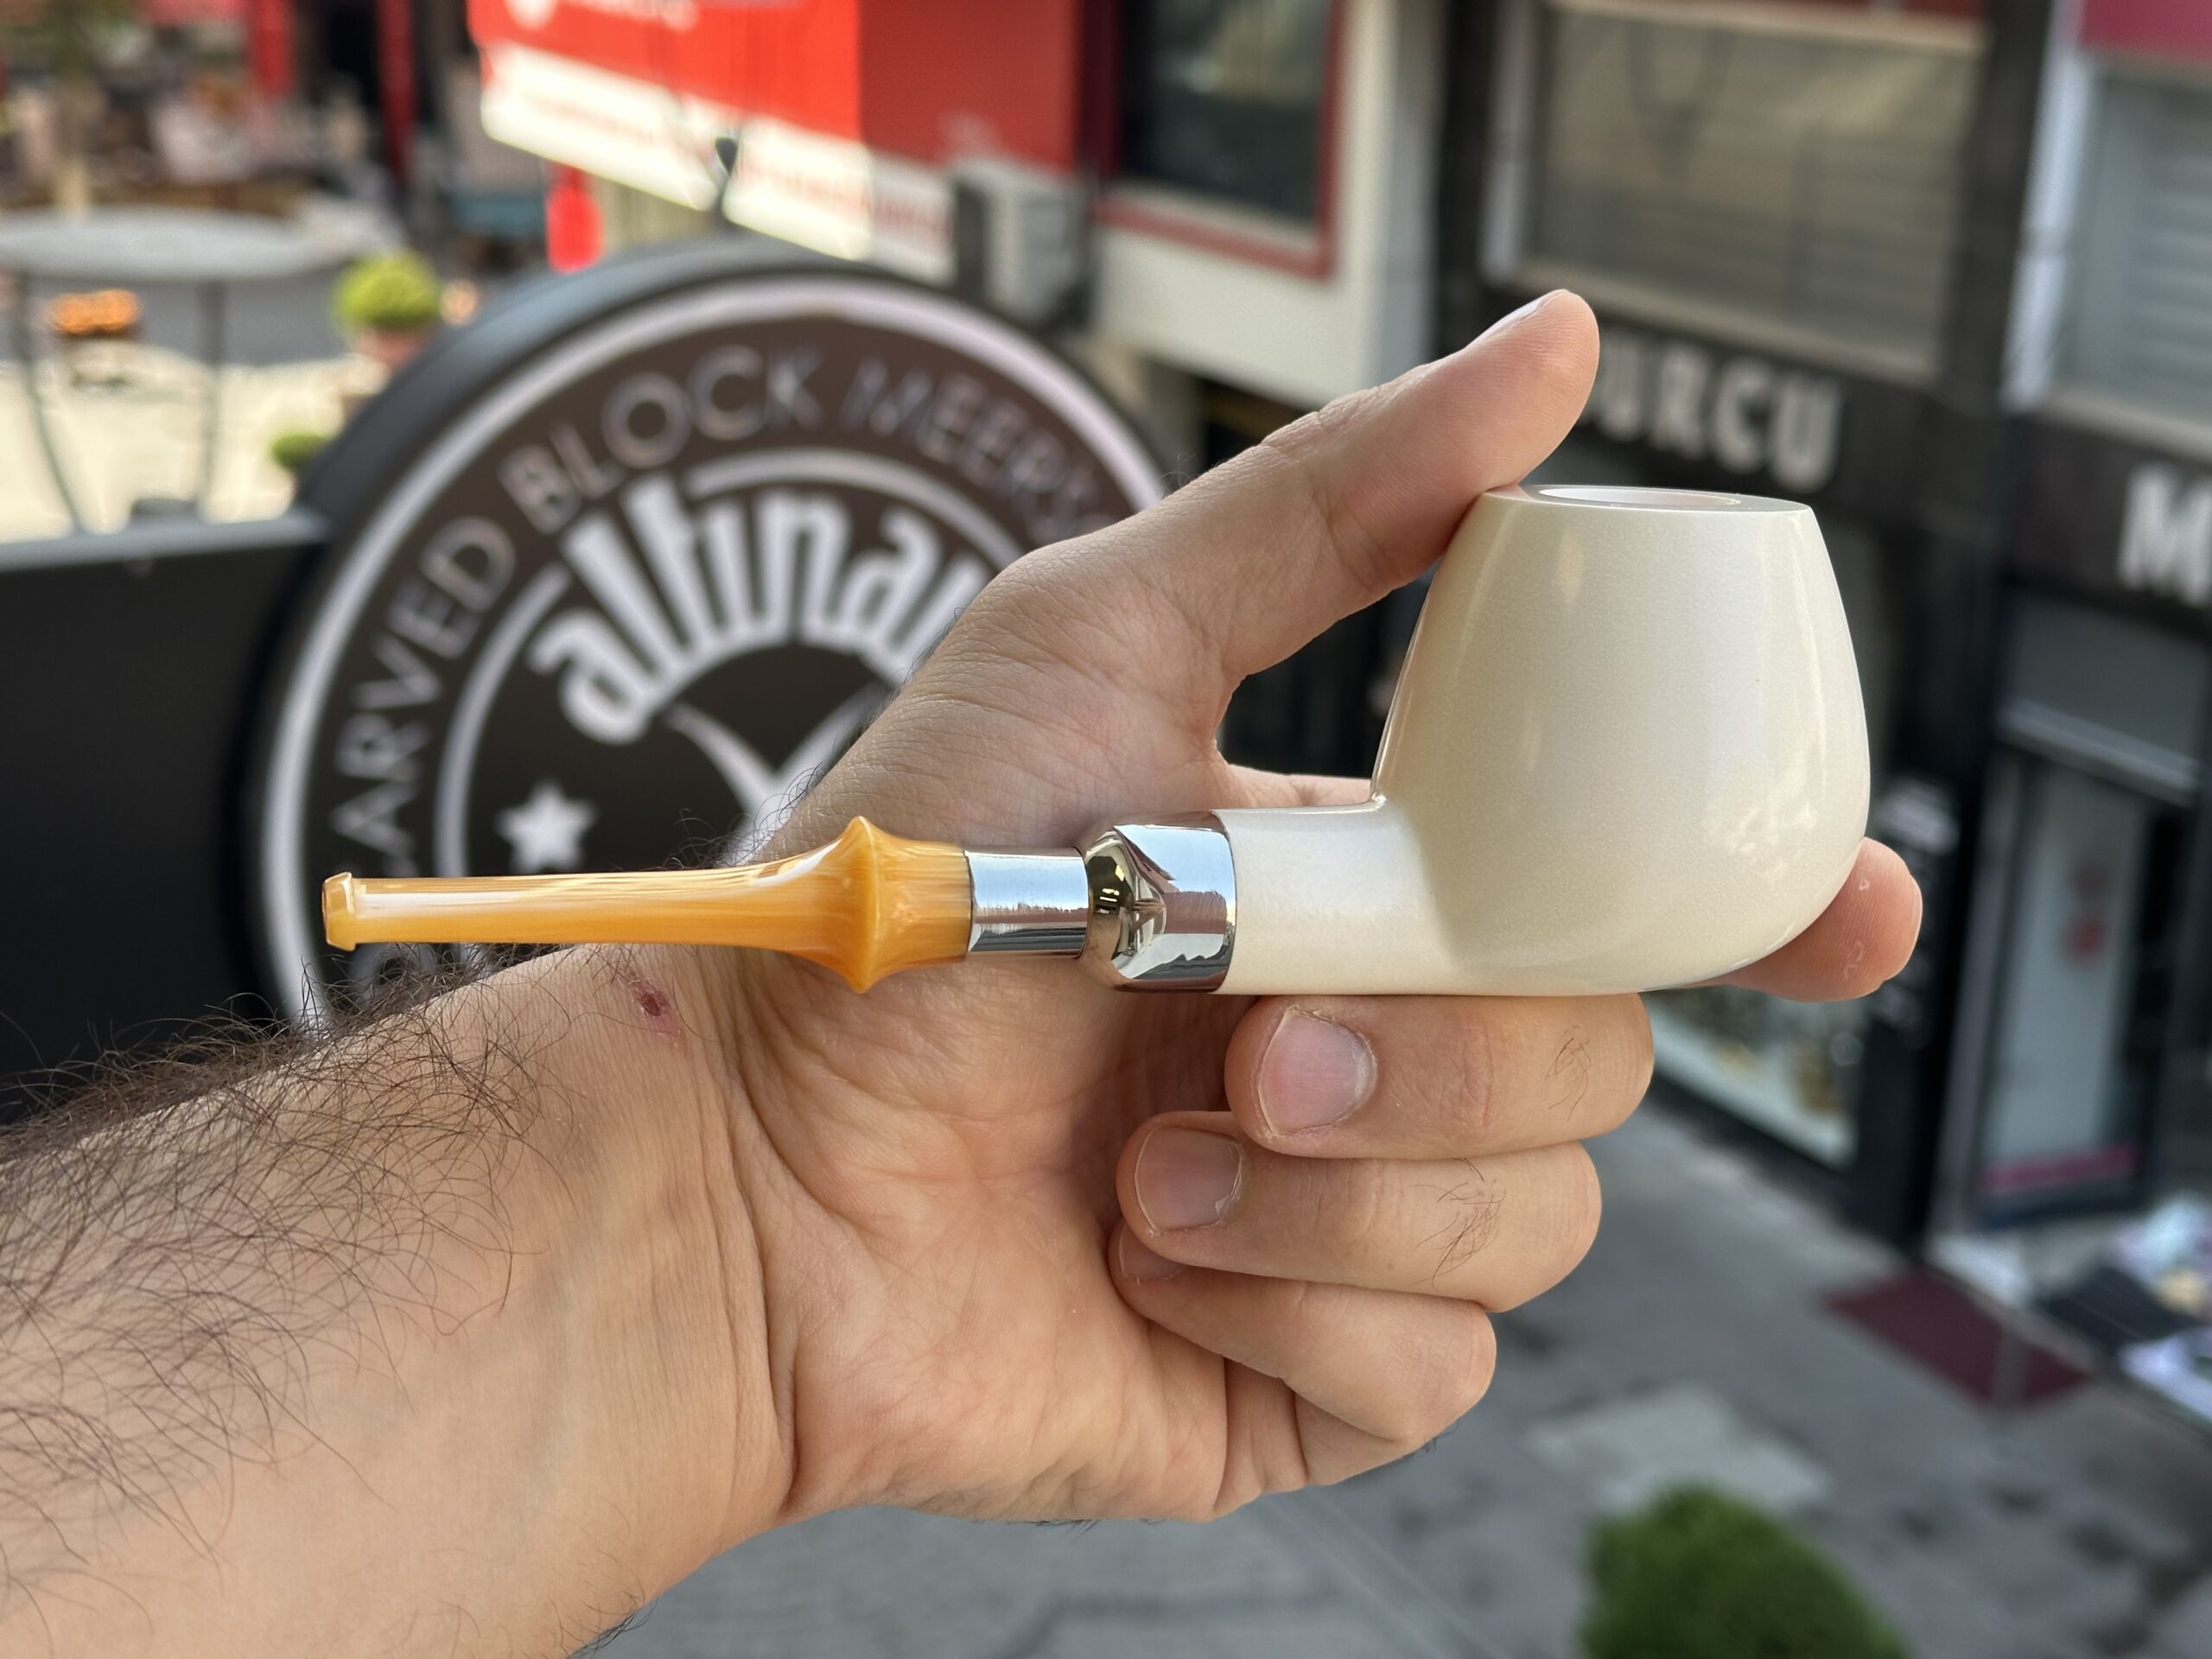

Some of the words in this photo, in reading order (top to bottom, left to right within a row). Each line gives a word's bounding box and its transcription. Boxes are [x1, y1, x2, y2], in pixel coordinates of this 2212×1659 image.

[1577, 327, 1842, 493] URCU
[332, 516, 517, 876] ARVED
[499, 342, 824, 533] BLOCK
